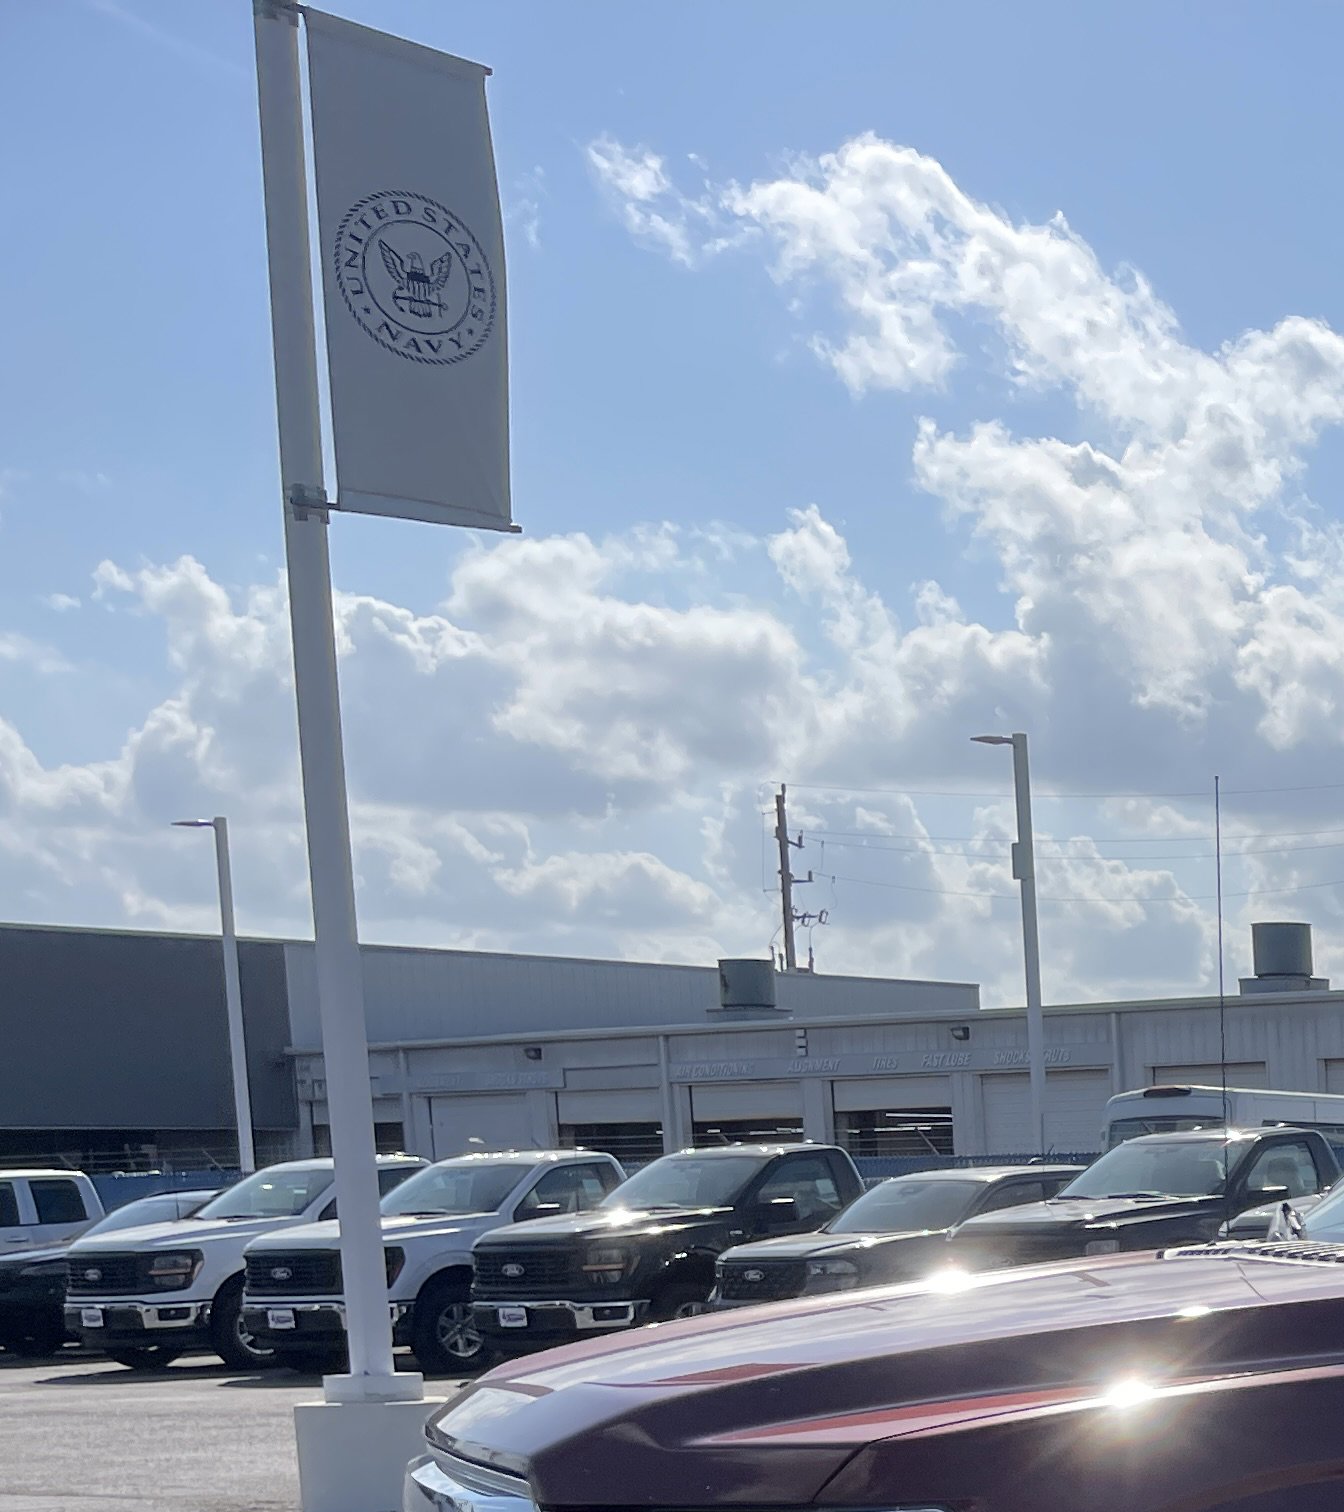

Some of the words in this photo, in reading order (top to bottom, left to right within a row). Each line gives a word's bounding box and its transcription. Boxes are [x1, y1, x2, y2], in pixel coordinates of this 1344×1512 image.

[344, 199, 412, 296] UNITED
[423, 206, 486, 322] STATES
[377, 320, 465, 355] NAVY
